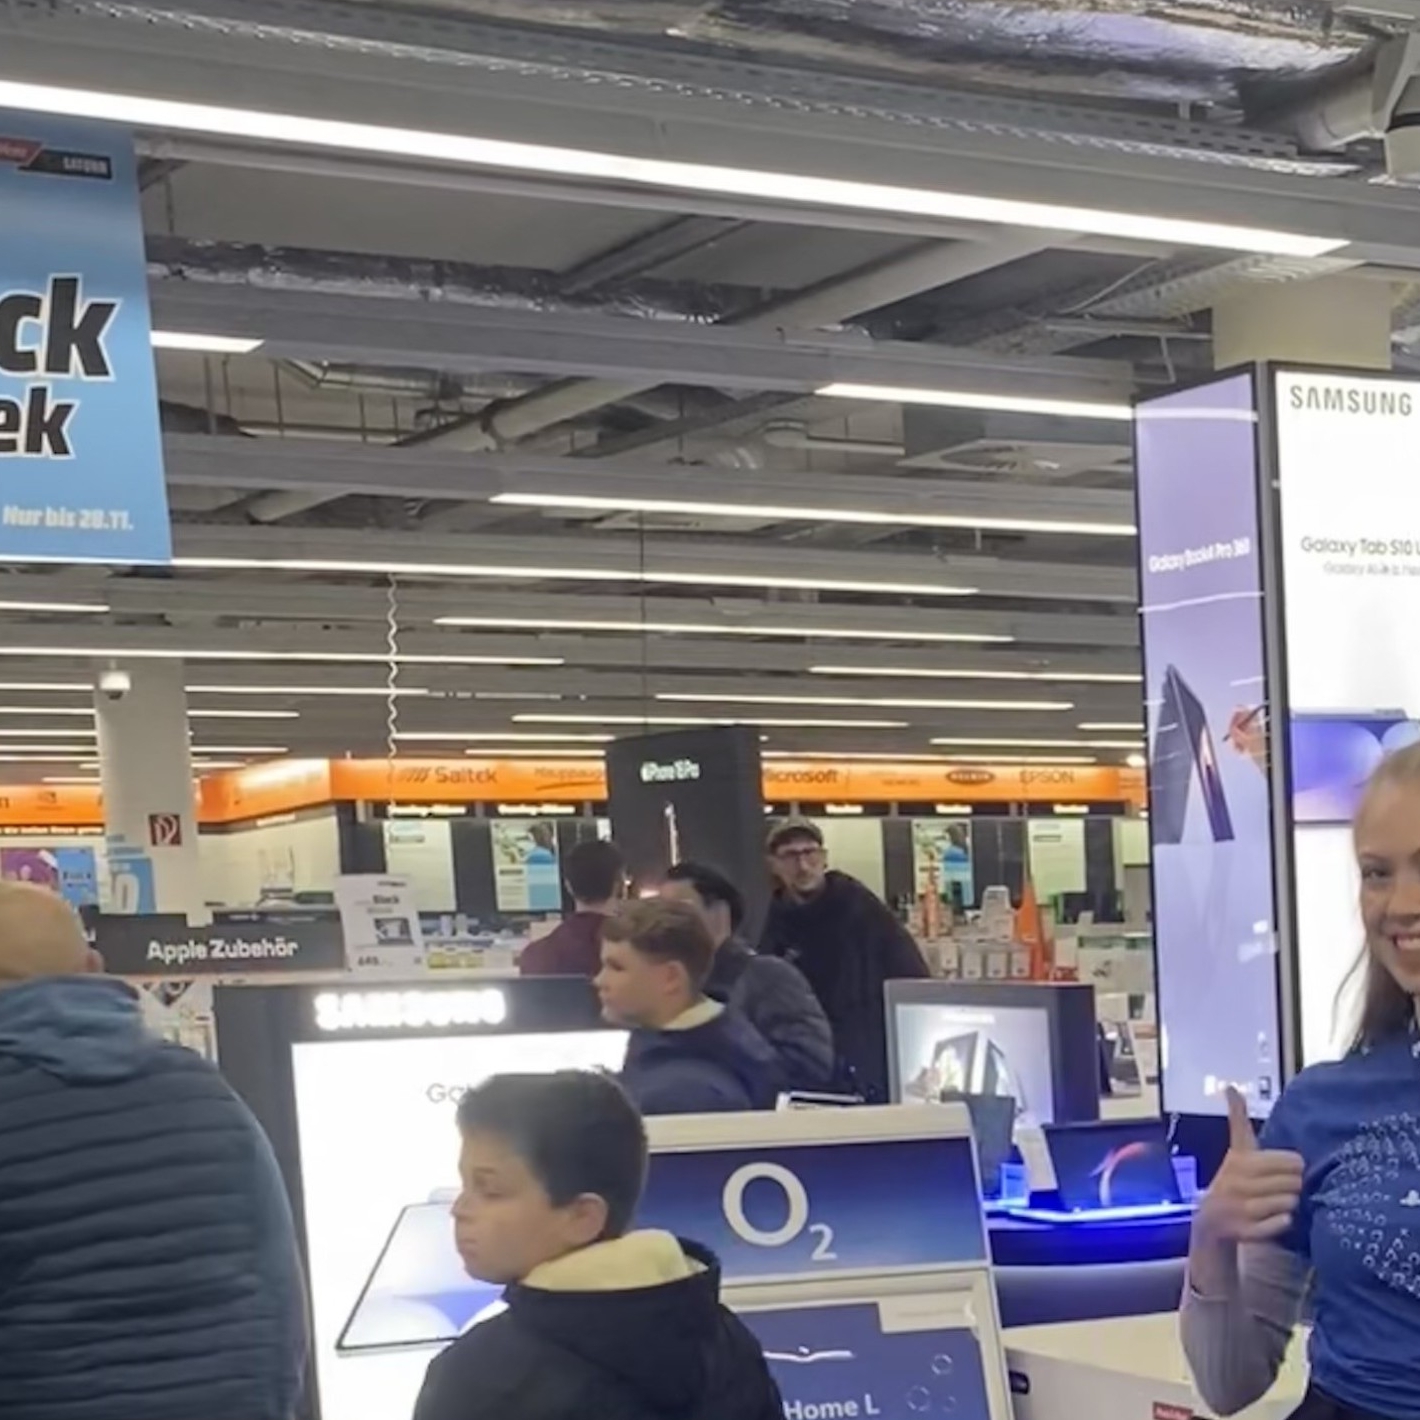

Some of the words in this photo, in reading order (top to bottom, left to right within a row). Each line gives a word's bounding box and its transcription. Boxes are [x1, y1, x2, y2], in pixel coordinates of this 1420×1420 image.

[1290, 385, 1412, 416] SAMSUNG
[3, 504, 43, 526] Nur
[46, 506, 77, 528] bis
[1301, 536, 1356, 558] Galaxy
[1360, 538, 1387, 555] Tab
[1390, 539, 1412, 556] S10
[435, 767, 498, 784] Saitek
[765, 766, 838, 784] icrosoft
[1020, 770, 1074, 784] EPSON
[147, 939, 208, 965] Apple
[209, 936, 298, 959] Zubehör
[864, 1393, 881, 1415] L
